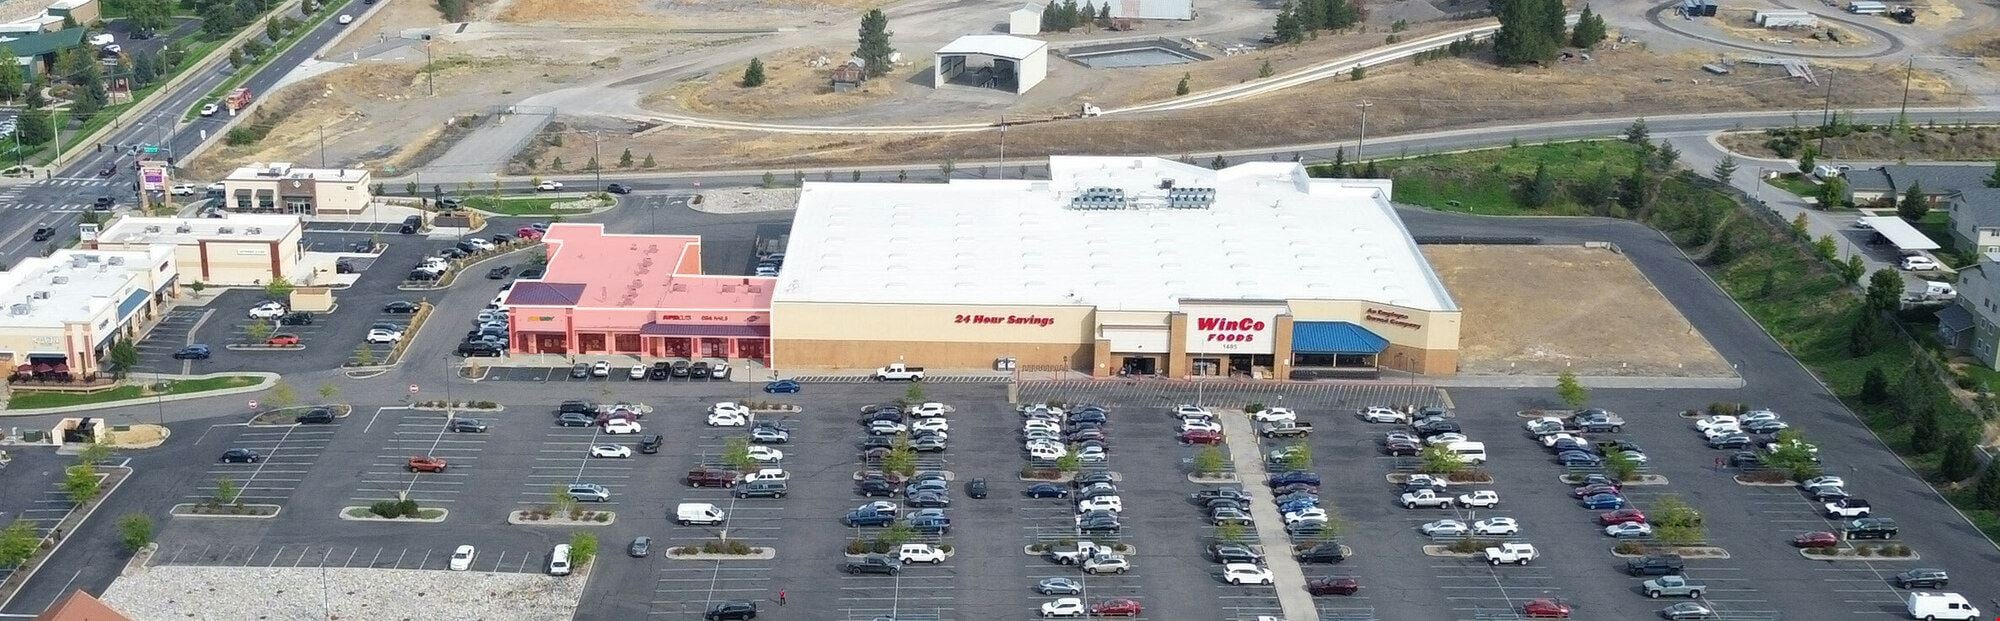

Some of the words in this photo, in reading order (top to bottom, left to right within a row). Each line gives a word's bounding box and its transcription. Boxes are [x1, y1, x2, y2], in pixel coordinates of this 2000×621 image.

[954, 314, 971, 324] 24
[973, 314, 1005, 324] Hour
[1007, 314, 1055, 327] Savings
[1197, 317, 1265, 331] WinCo
[1207, 333, 1254, 342] FOODS
